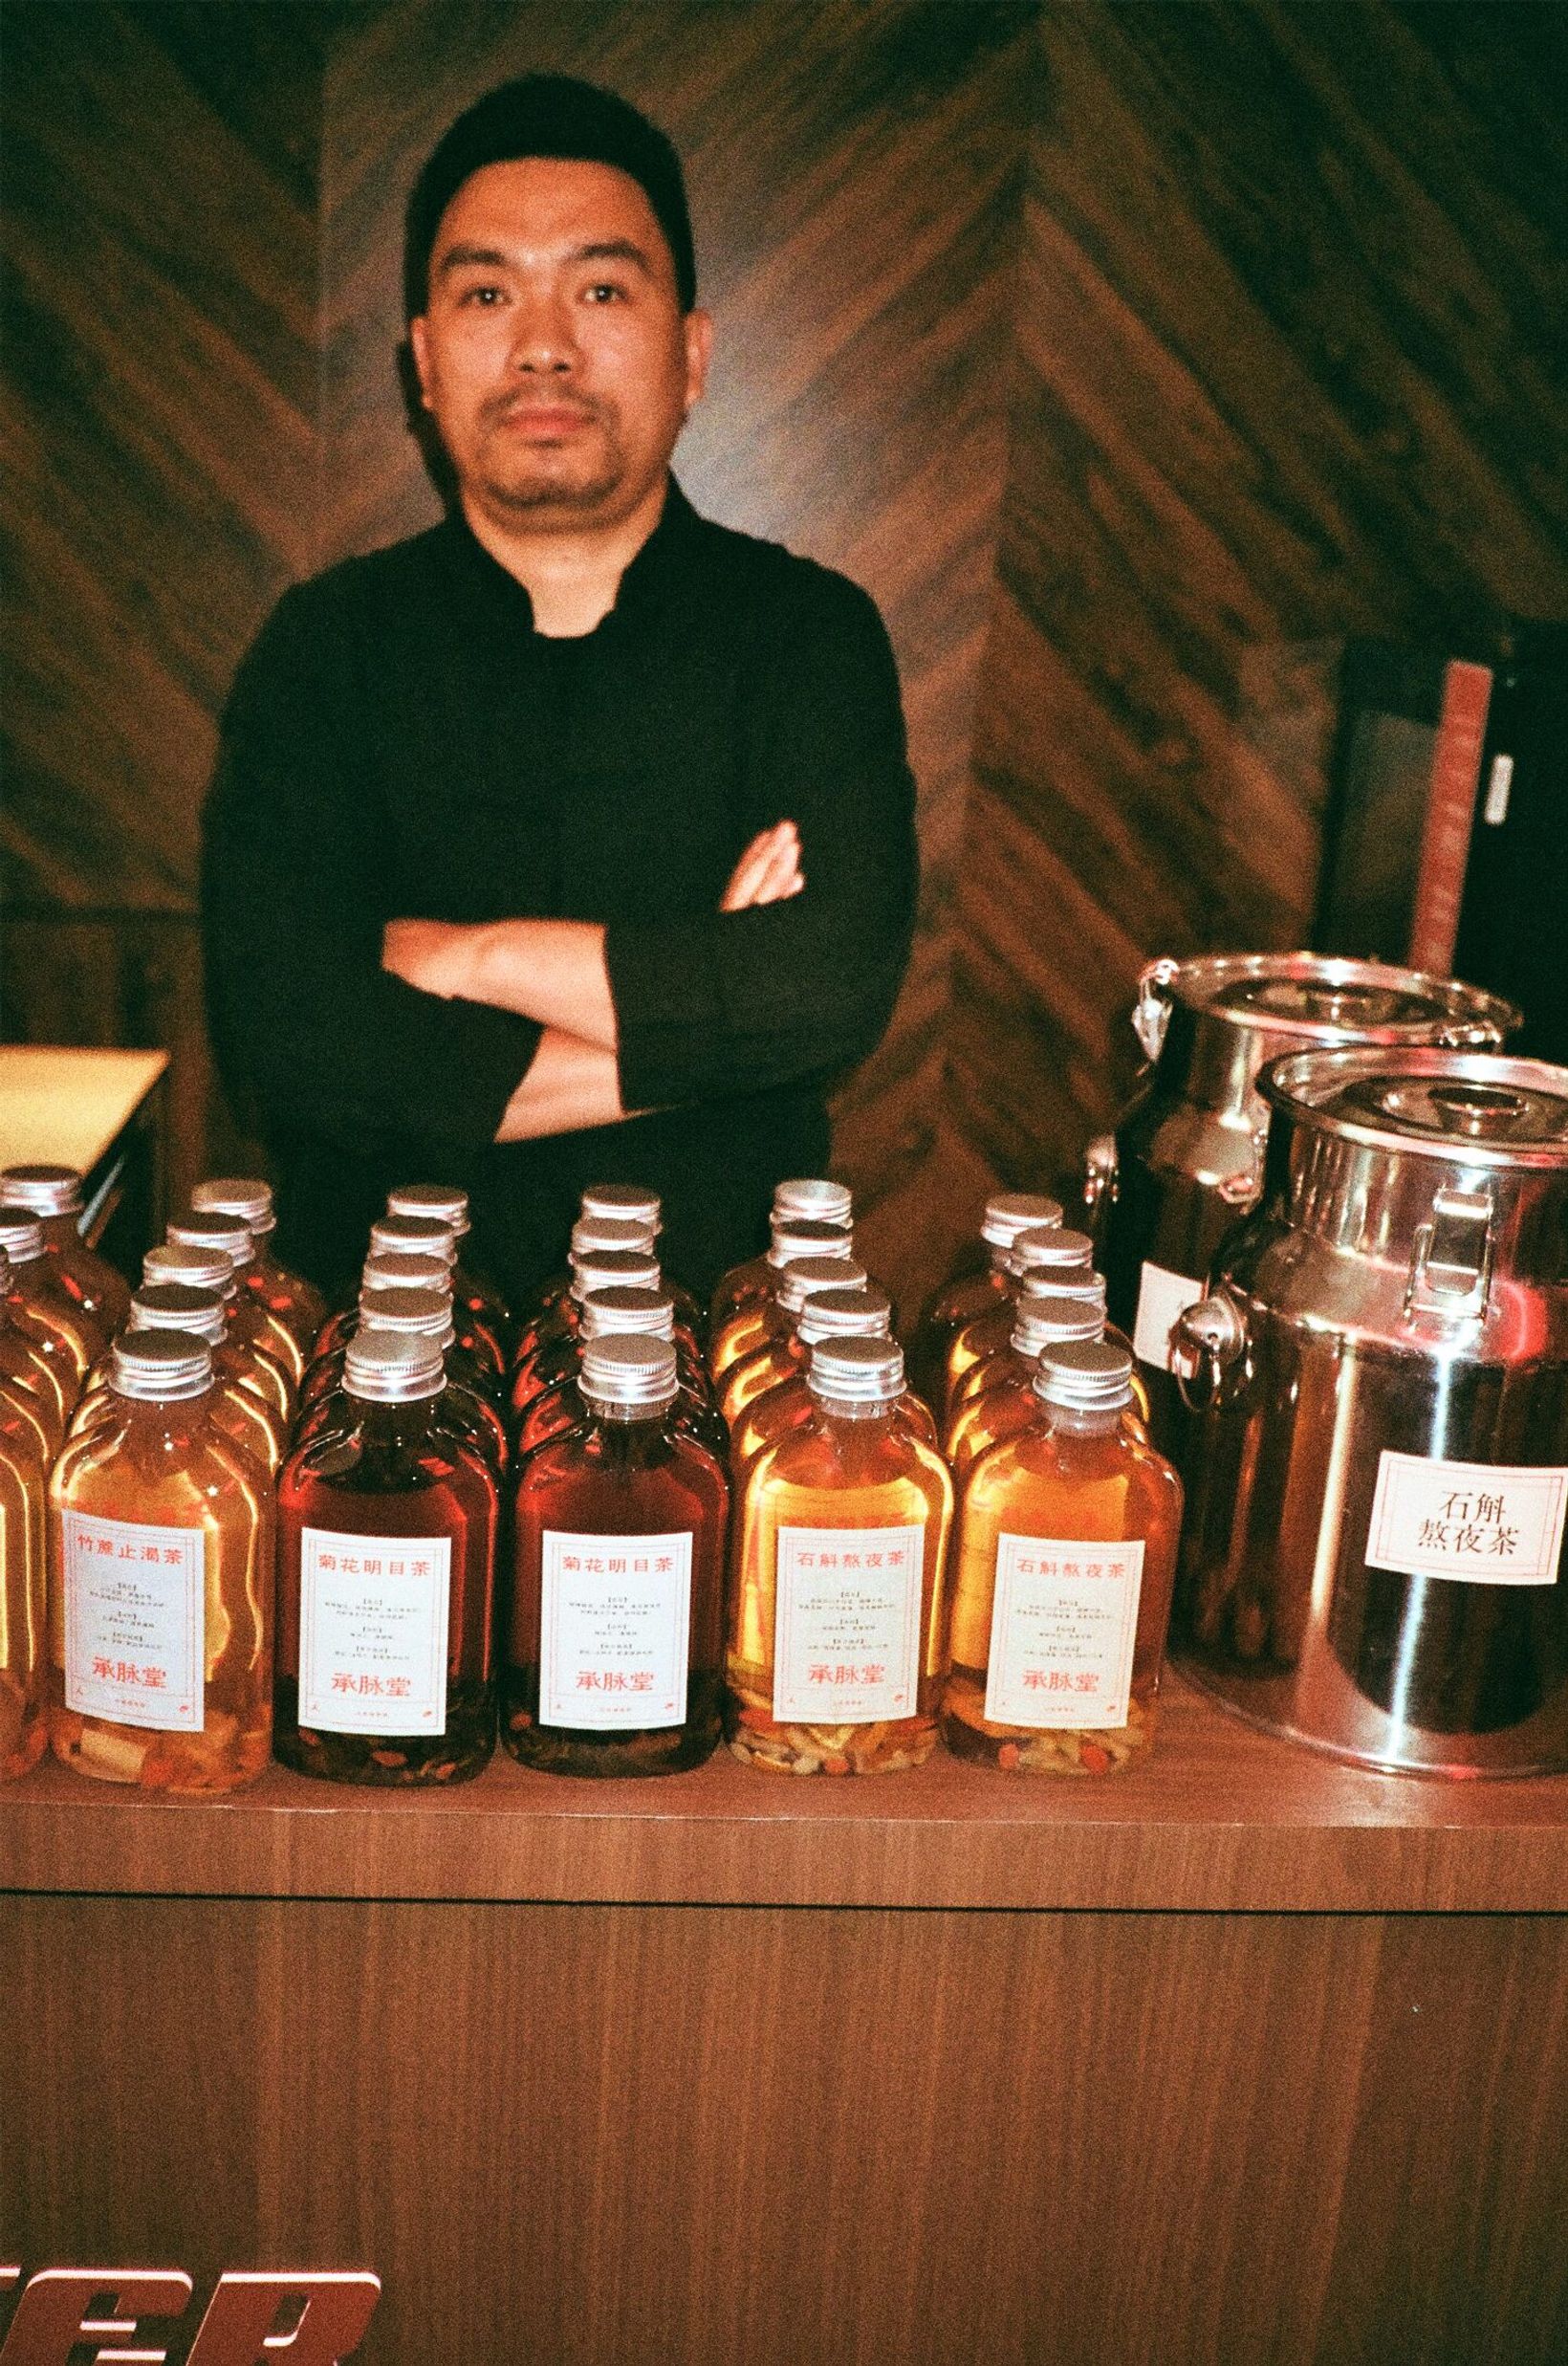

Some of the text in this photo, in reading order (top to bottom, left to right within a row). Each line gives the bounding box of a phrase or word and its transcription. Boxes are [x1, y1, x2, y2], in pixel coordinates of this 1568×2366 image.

[1440, 1490, 1507, 1524] 石斛
[1418, 1519, 1519, 1557] 熬夜茶
[317, 1554, 431, 1577] 菊花明目茶
[562, 1555, 674, 1574] 菊花明目茶
[796, 1549, 906, 1570] 石斛熬夜茶
[1016, 1558, 1126, 1579] 石斛熬夜茶
